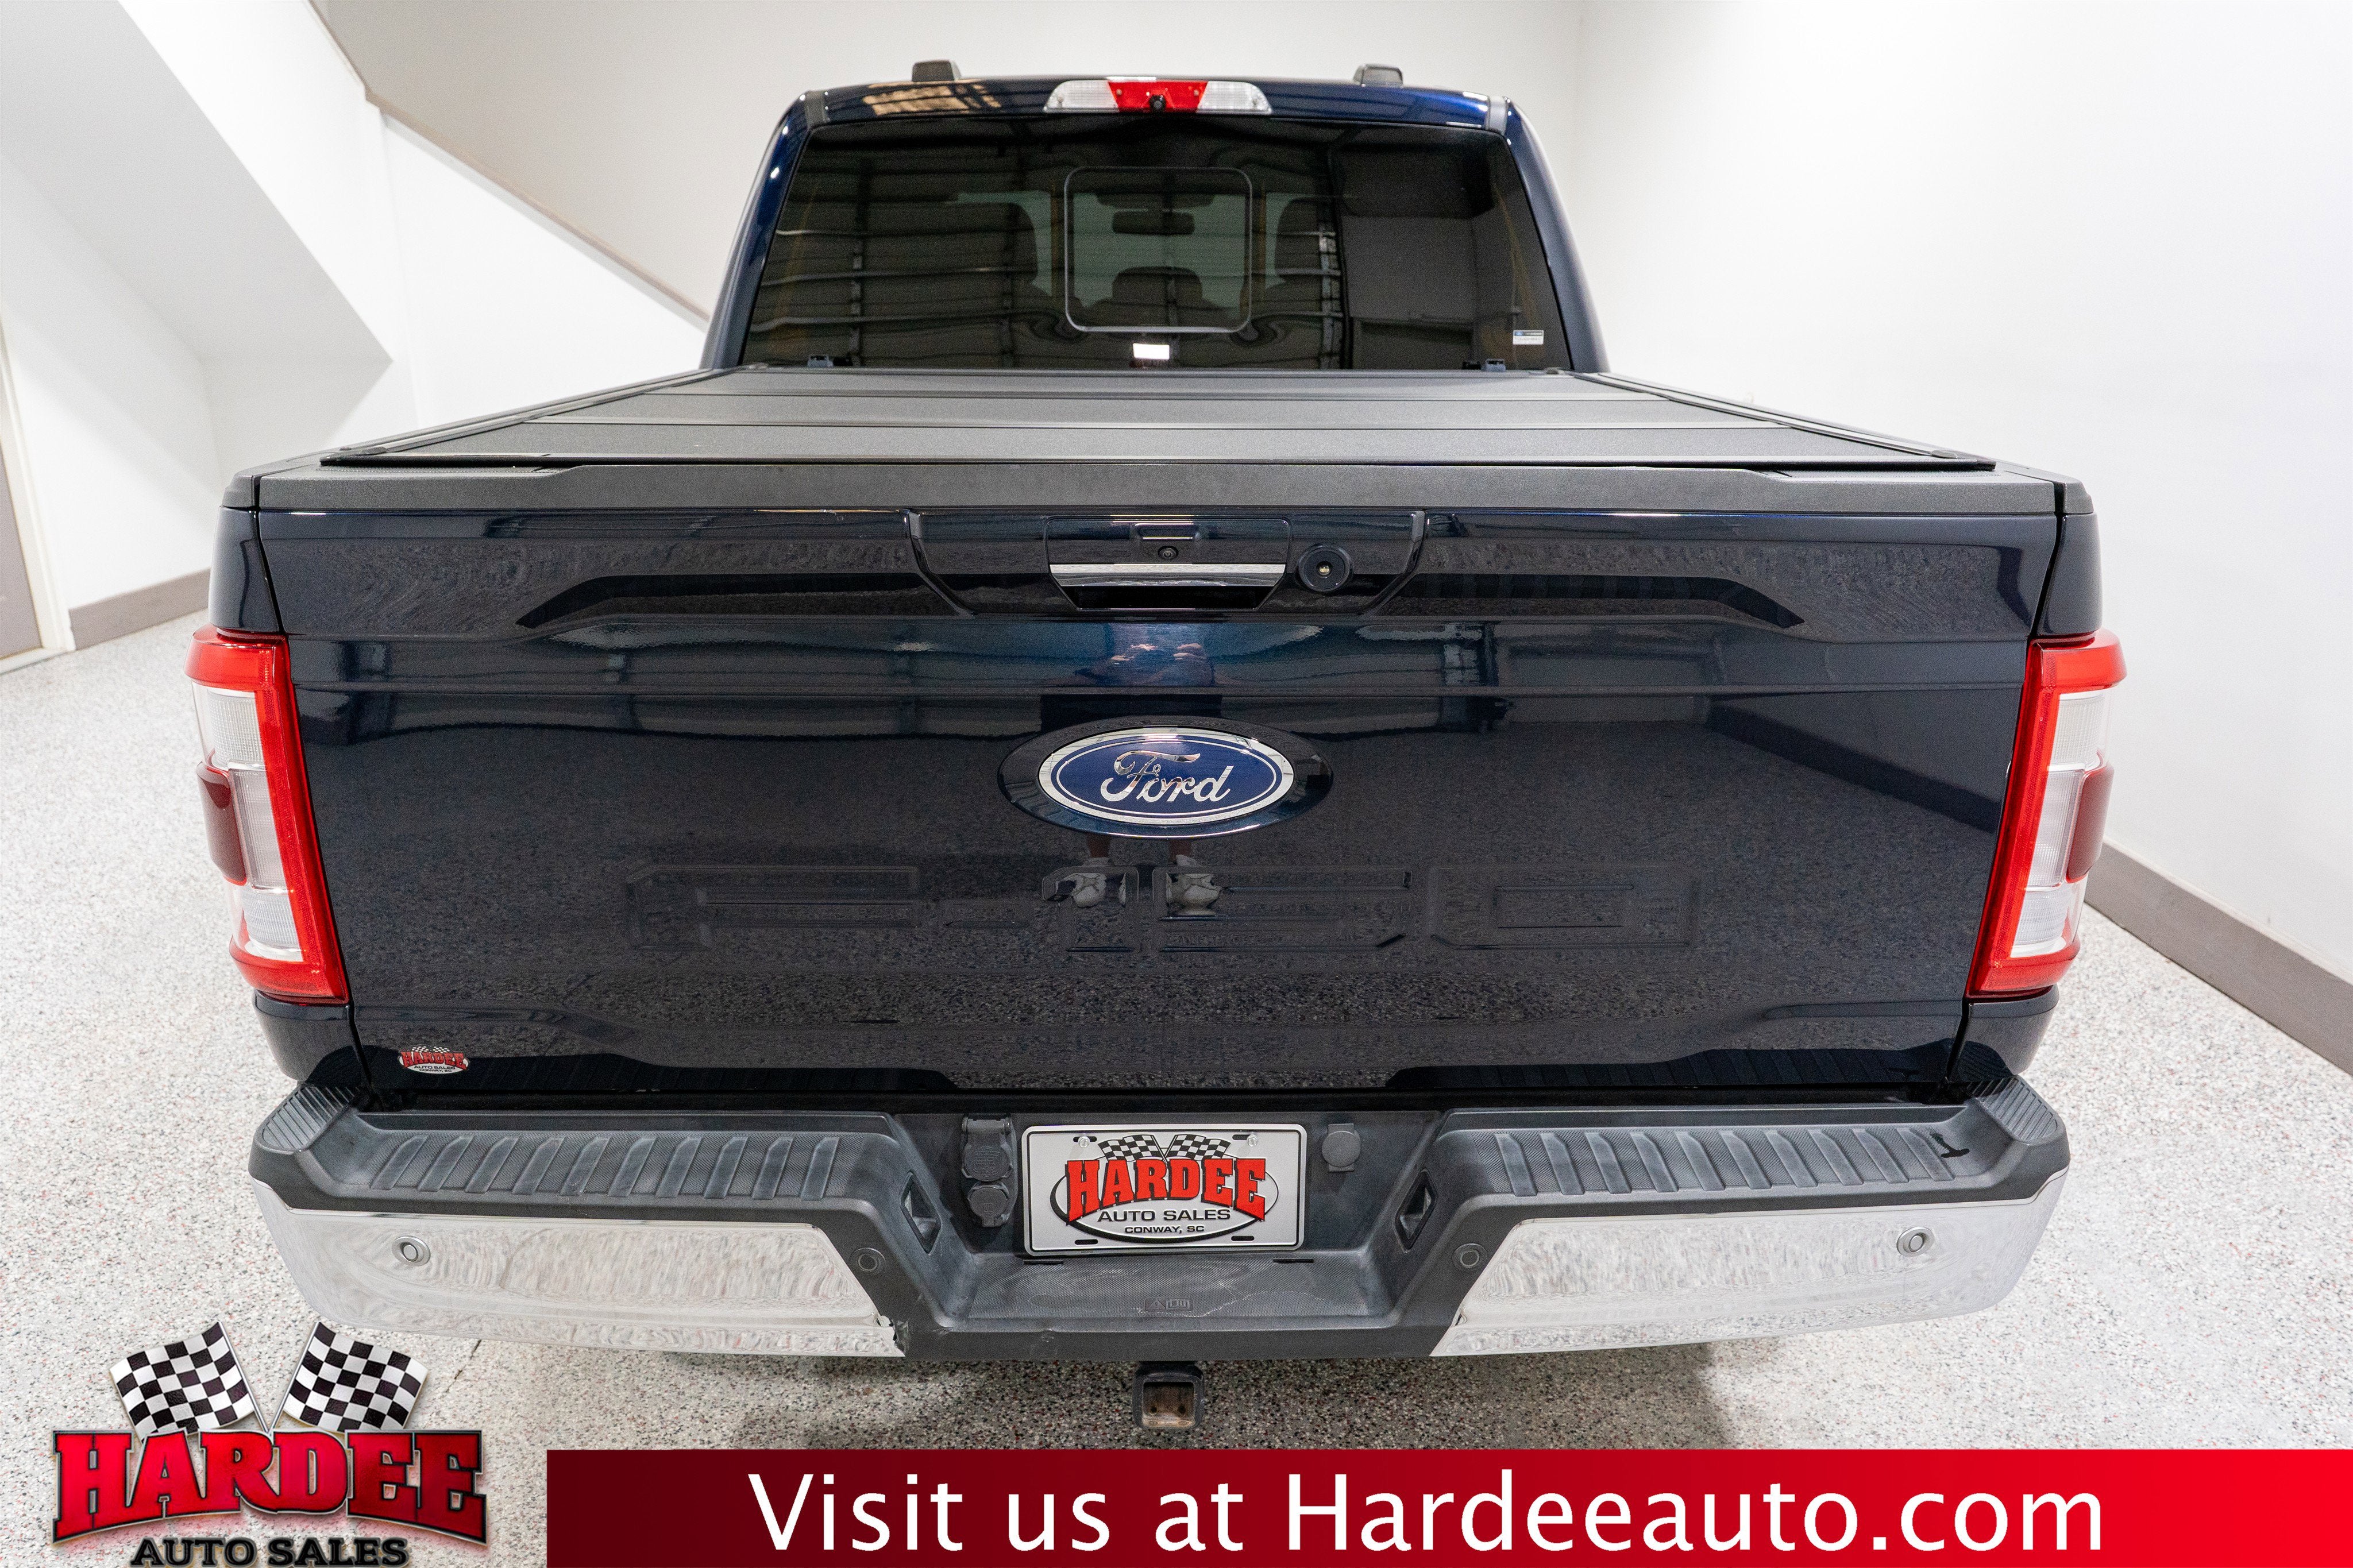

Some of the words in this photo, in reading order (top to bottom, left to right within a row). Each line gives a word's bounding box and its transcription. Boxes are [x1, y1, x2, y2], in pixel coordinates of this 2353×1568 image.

[1101, 750, 1234, 803] Ford
[400, 1051, 467, 1069] HARDEE
[1065, 1158, 1266, 1225] HARDEE
[1097, 1210, 1155, 1222] AUTO
[1163, 1209, 1230, 1221] SALES
[1124, 1226, 1182, 1234] CONWAY,
